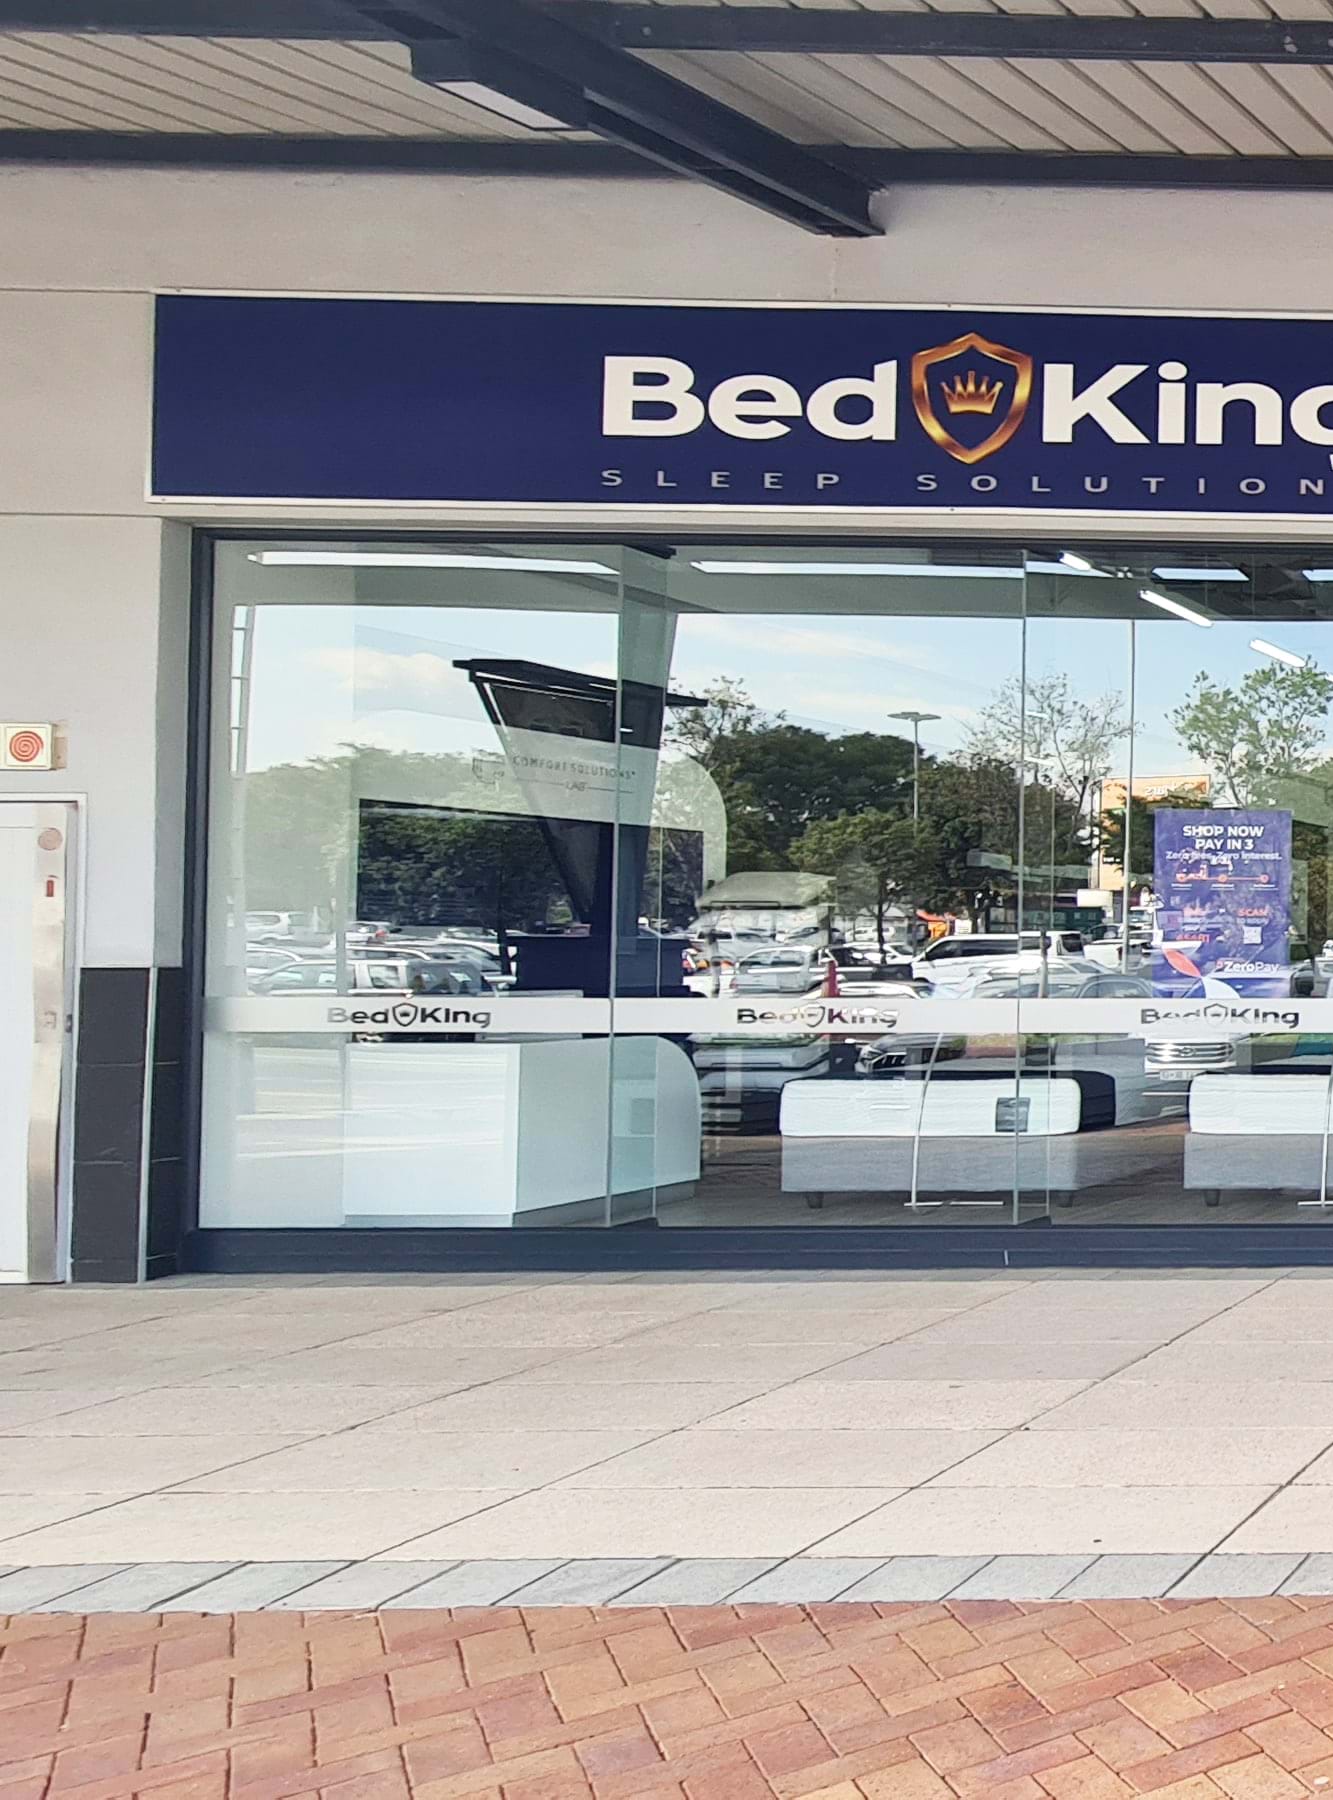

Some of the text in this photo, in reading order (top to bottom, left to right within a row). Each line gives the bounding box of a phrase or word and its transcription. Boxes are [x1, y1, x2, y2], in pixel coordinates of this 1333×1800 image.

[602, 356, 898, 441] Bed
[602, 469, 841, 491] SLEEP
[1182, 825, 1264, 837] SHOP NOW
[1195, 839, 1254, 850] PAY IN 3
[1224, 960, 1280, 973] ZeroPay
[327, 1005, 491, 1027] Bed King
[1230, 1007, 1300, 1028] King
